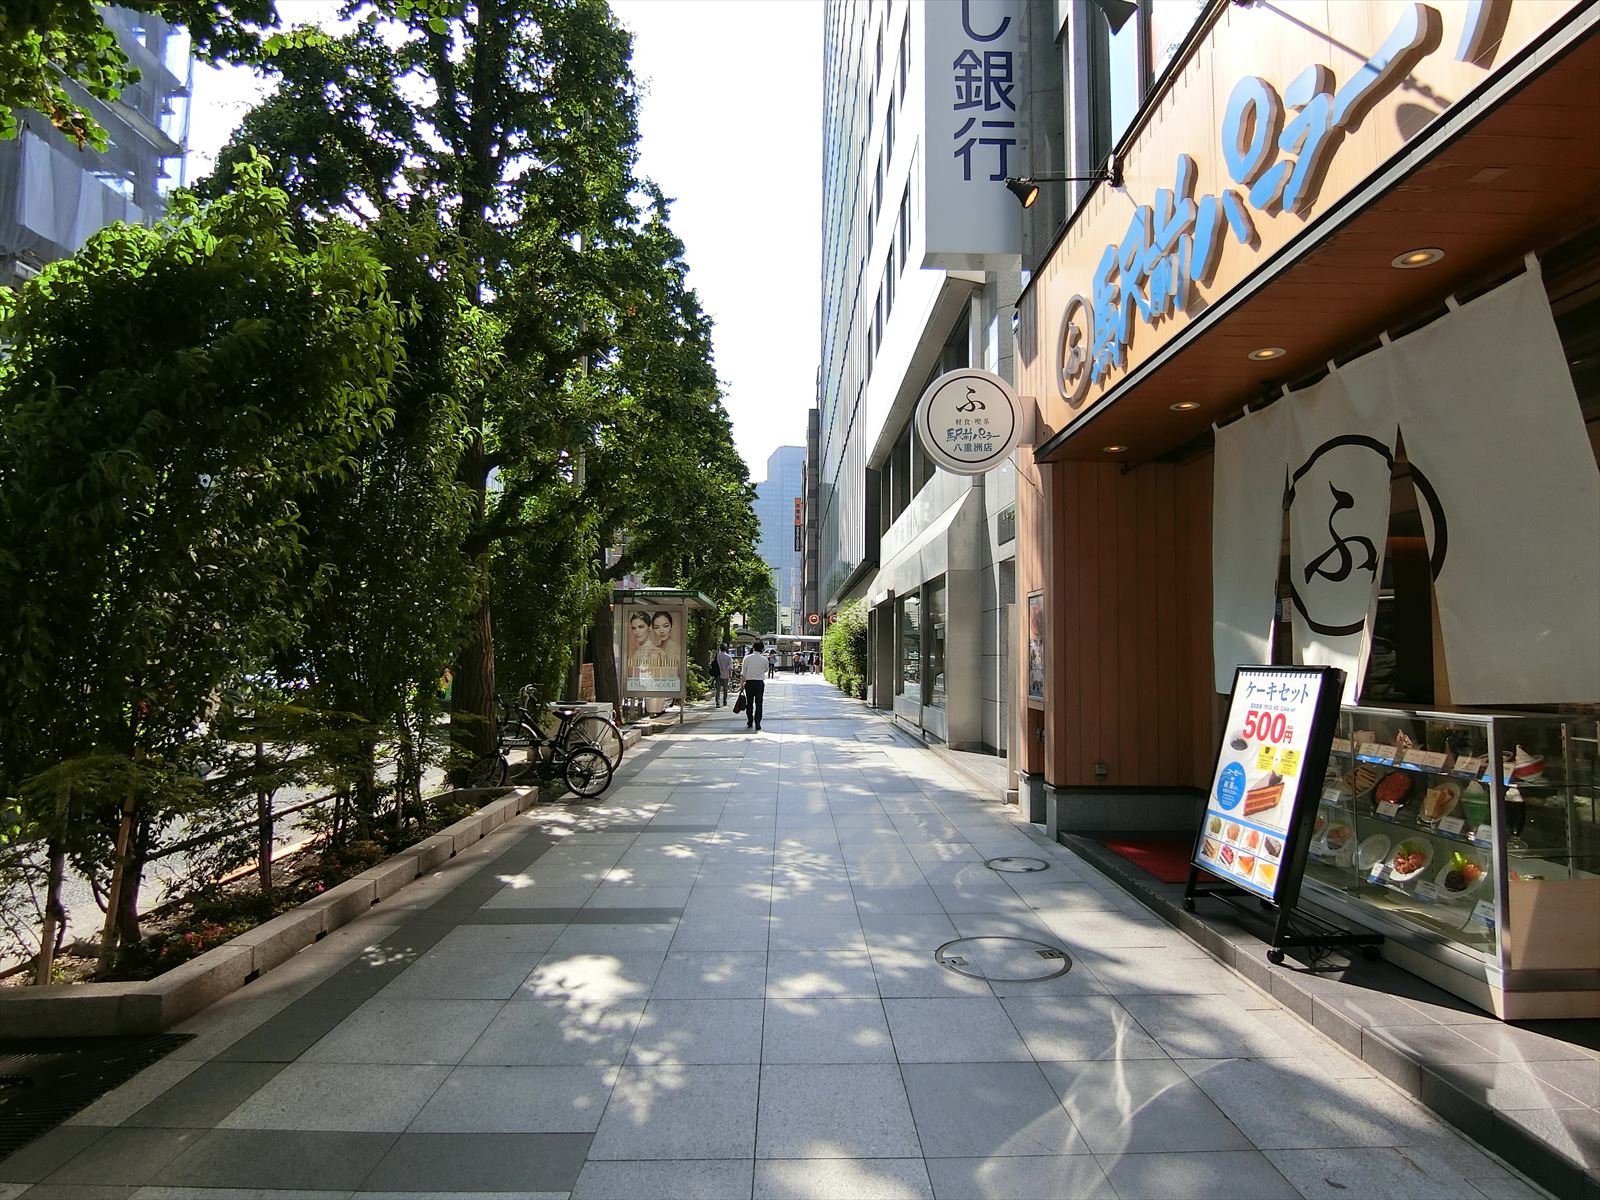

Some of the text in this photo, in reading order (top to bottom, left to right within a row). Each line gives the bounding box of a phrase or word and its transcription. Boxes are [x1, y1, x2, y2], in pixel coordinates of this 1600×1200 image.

[956, 385, 986, 412] ふ
[946, 427, 1000, 443] 駅前パーラー
[953, 443, 993, 453] 八重洲店
[1304, 479, 1380, 585] ふ
[1246, 681, 1309, 704] ケーキセット
[1242, 709, 1294, 745] 500円
